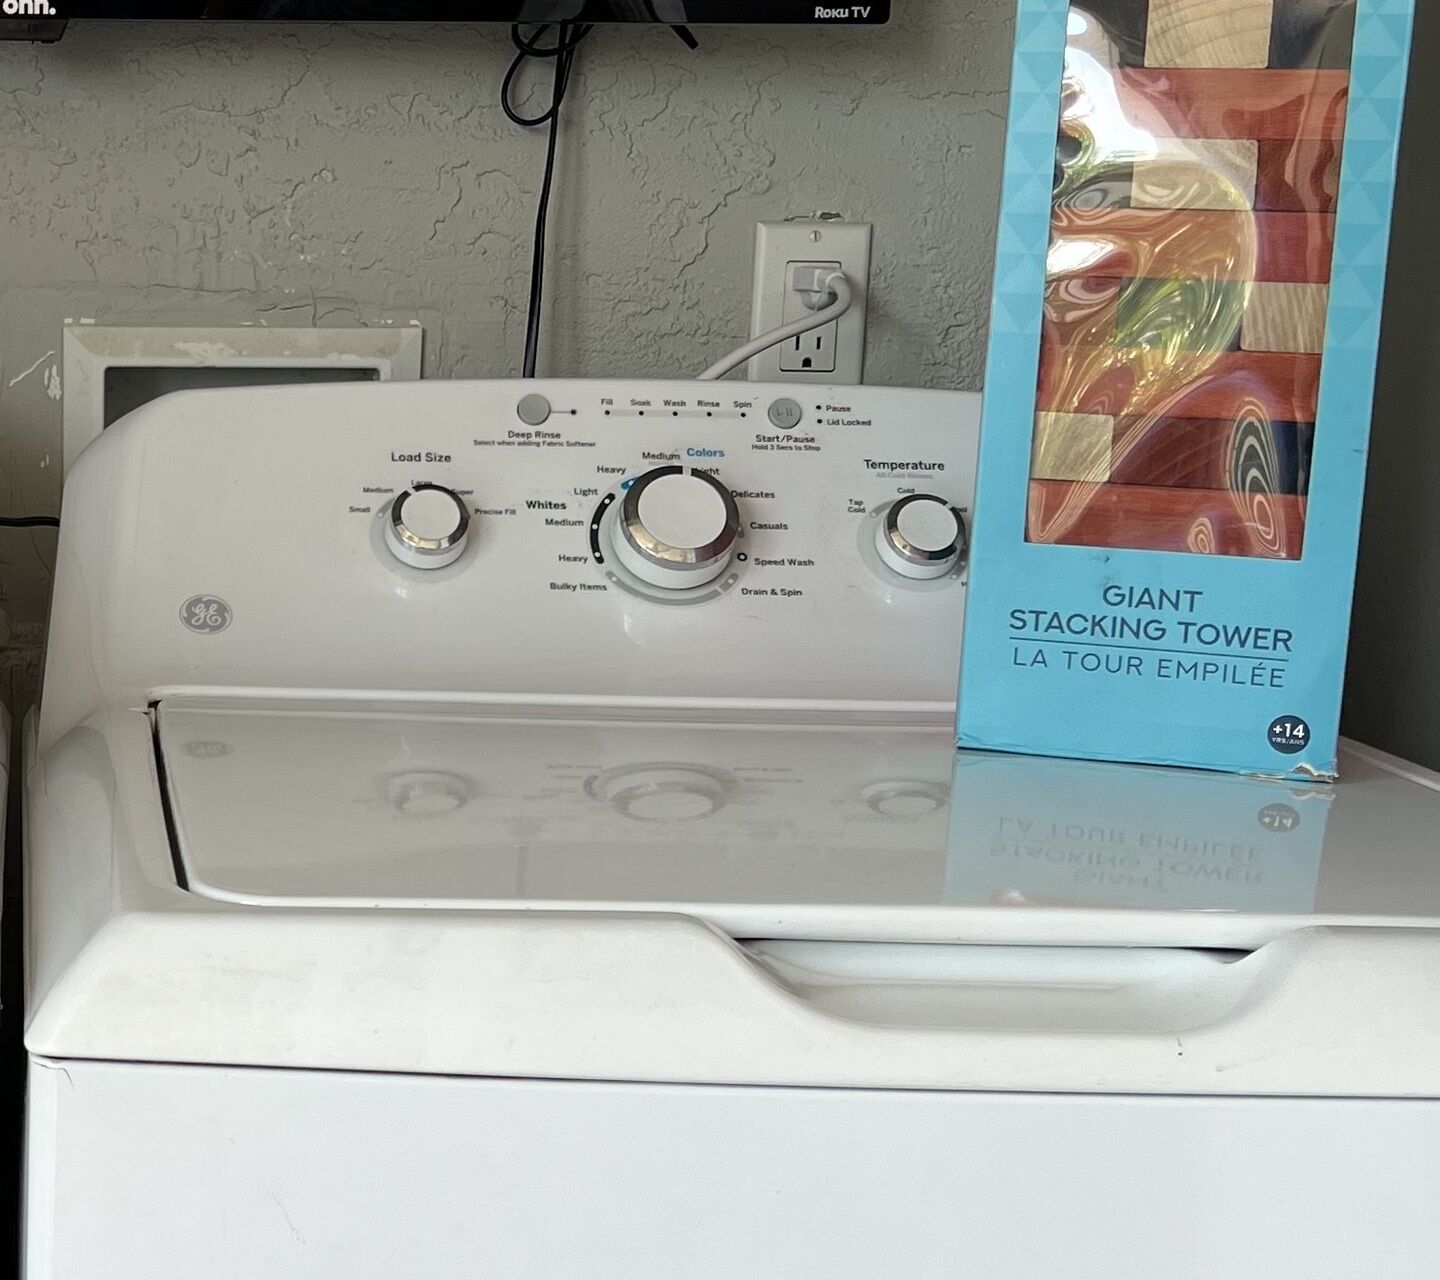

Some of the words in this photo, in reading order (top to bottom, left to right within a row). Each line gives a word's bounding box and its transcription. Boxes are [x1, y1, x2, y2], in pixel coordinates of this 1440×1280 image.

[814, 6, 849, 19] Roku
[851, 6, 872, 18] TV
[600, 398, 613, 406] Fill
[630, 399, 651, 407] Soak
[663, 399, 686, 407] Wash
[697, 400, 720, 408] Rinse
[732, 400, 752, 409] Spin
[507, 430, 533, 440] Deep
[534, 430, 561, 439] Rinse
[755, 434, 816, 443] Start/Pause
[391, 451, 422, 463] Load
[425, 451, 452, 463] Size
[642, 451, 681, 461] Medium
[686, 447, 726, 458] Colors
[596, 464, 627, 476] Heavy
[863, 458, 945, 472] Temperature
[573, 487, 599, 497] Light
[729, 489, 776, 499] Delicates
[525, 500, 567, 510] Whites
[848, 498, 864, 506] Tap
[474, 508, 503, 516] Precise
[504, 508, 517, 516] Fill
[847, 506, 866, 514] Cold
[545, 518, 584, 527] Medium
[749, 521, 789, 530] Casuals
[558, 554, 589, 565] Heavy
[753, 557, 785, 568] Speed
[786, 558, 815, 567] Wash
[549, 582, 577, 592] Bulky
[578, 583, 608, 592] Items
[741, 587, 768, 596] Drain
[770, 588, 779, 597] &
[779, 588, 803, 598] Spin
[1101, 583, 1204, 614] GIANT
[1008, 608, 1168, 642] STACKING
[1177, 621, 1294, 653] TOWER
[1012, 646, 1049, 669] LA
[1062, 650, 1143, 677] TOUR
[1157, 657, 1287, 689] EMPILÉE
[1272, 723, 1305, 739] +14
